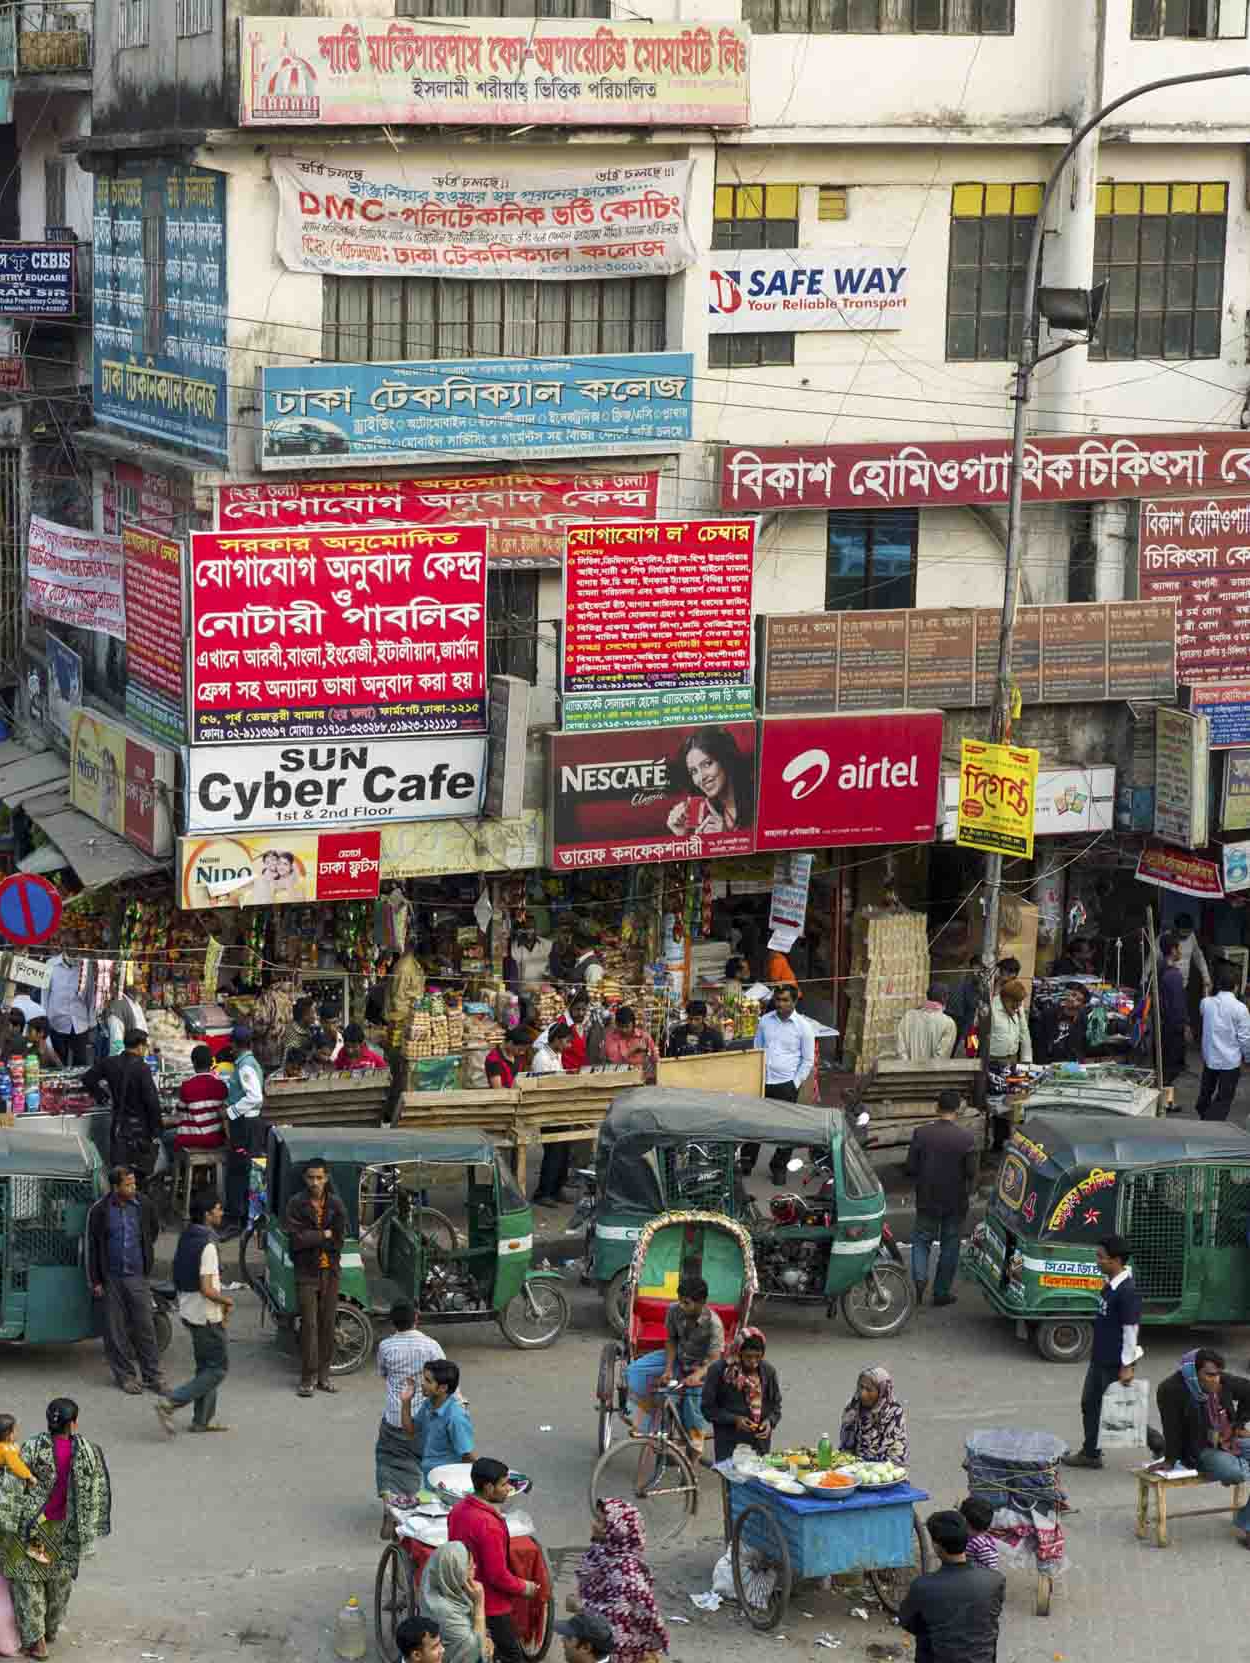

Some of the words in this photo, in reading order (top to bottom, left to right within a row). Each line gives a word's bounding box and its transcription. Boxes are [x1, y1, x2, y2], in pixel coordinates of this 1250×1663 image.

[633, 27, 712, 75] সোসাইটি
[413, 75, 469, 98] ইসলামী
[535, 76, 581, 99] ভিত্তিক
[588, 76, 657, 99] পরিচালিত
[552, 198, 595, 225] ভর্তি
[600, 190, 681, 223] কোচিং
[31, 252, 70, 269] CEBIS
[393, 244, 438, 265] ঢাকা
[25, 273, 68, 282] EDUCARE
[747, 269, 824, 297] SAFE
[834, 267, 907, 295] WAY
[36, 288, 66, 297] SIR
[748, 299, 777, 312] Your
[782, 298, 838, 311] Reliable
[843, 298, 907, 312] Transport
[270, 384, 358, 416] ঢাকা
[370, 376, 565, 414] টেকনিক্যাল
[574, 376, 688, 403] কলেজ
[726, 450, 837, 501] বিকাশ
[1077, 438, 1209, 490] চিকিৎসা
[224, 492, 403, 518] যোগাযোগ
[419, 489, 544, 513] অনুবাদ
[561, 487, 649, 508] কেন্দ্র
[1145, 504, 1187, 537] বিকাশ
[217, 538, 310, 553] সরকার
[321, 530, 460, 552] অনুমোদিত
[568, 526, 660, 545] যোগাযোগ
[697, 524, 751, 542] চেম্বার
[1144, 544, 1220, 569] চিকিৎসা
[195, 552, 317, 588] যোগাযোগ
[324, 551, 413, 592] অনুবাদ
[423, 551, 483, 582] কেন্দ্র
[331, 589, 352, 607] ও
[197, 600, 326, 639] নোটারী
[342, 596, 481, 633] পাবলিক
[197, 648, 239, 670] এখানে
[237, 681, 262, 701] সহ
[265, 679, 318, 698] অন্যান্য
[322, 676, 356, 697] ভাষা
[361, 674, 413, 700] অনুবাদ
[418, 673, 447, 692] করা
[452, 672, 473, 690] হয়
[279, 747, 368, 772] SUN
[561, 757, 670, 793] NESCAFÉ
[838, 755, 919, 790] airtel
[199, 771, 346, 820] Cyber
[363, 763, 475, 804] Cafe
[275, 811, 298, 822] 1st
[303, 810, 314, 820] &
[320, 808, 348, 820] 2nd
[353, 805, 395, 817] Floor
[319, 860, 345, 876] ঢাকা
[558, 848, 607, 865] তায়েফ
